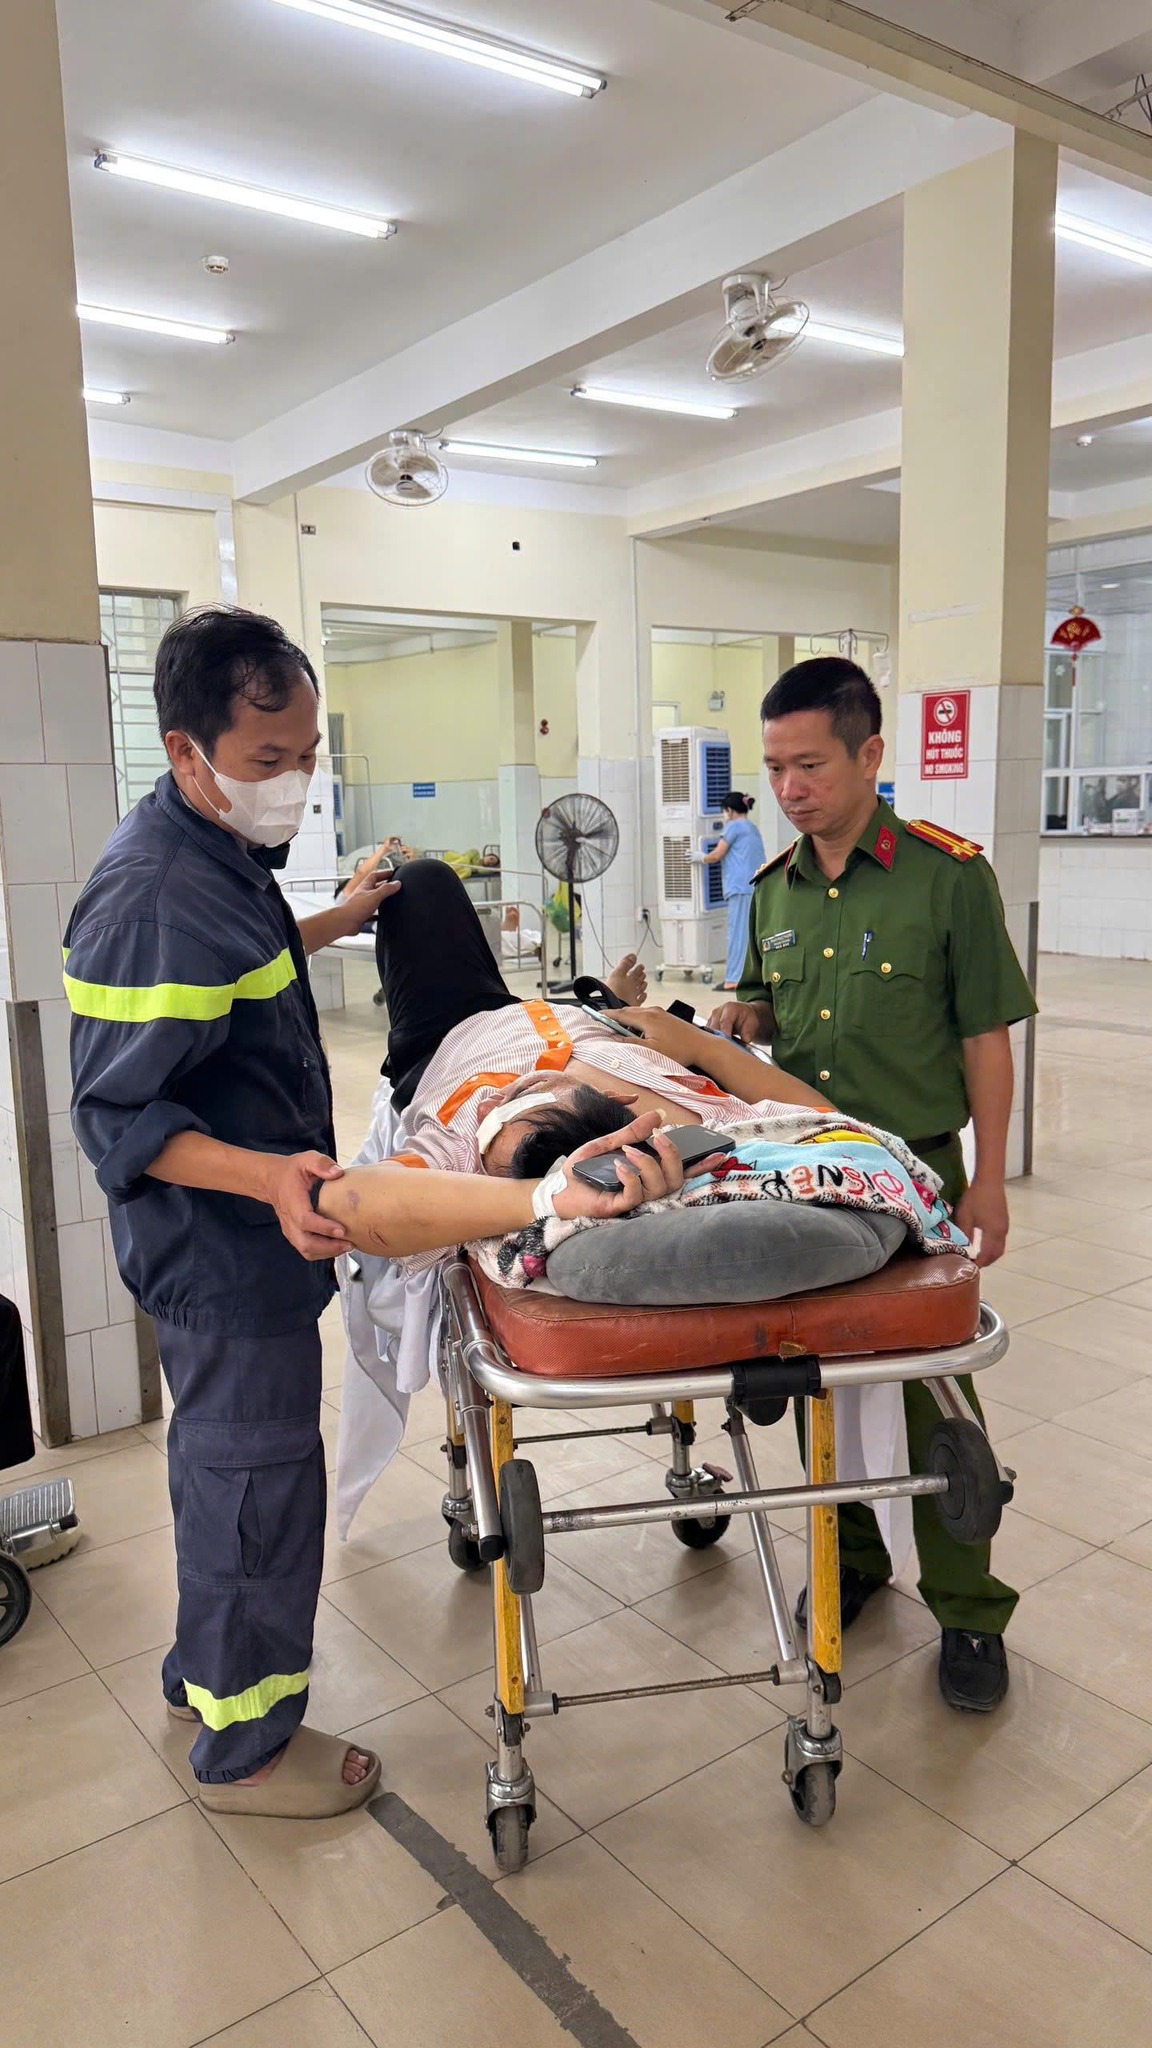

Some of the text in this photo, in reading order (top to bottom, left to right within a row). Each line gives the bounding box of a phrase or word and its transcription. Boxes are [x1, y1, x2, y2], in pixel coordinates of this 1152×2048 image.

[928, 729, 962, 744] KHÔNG
[926, 745, 963, 760] HÚT THUỐC
[925, 763, 964, 775] NO SMOKING
